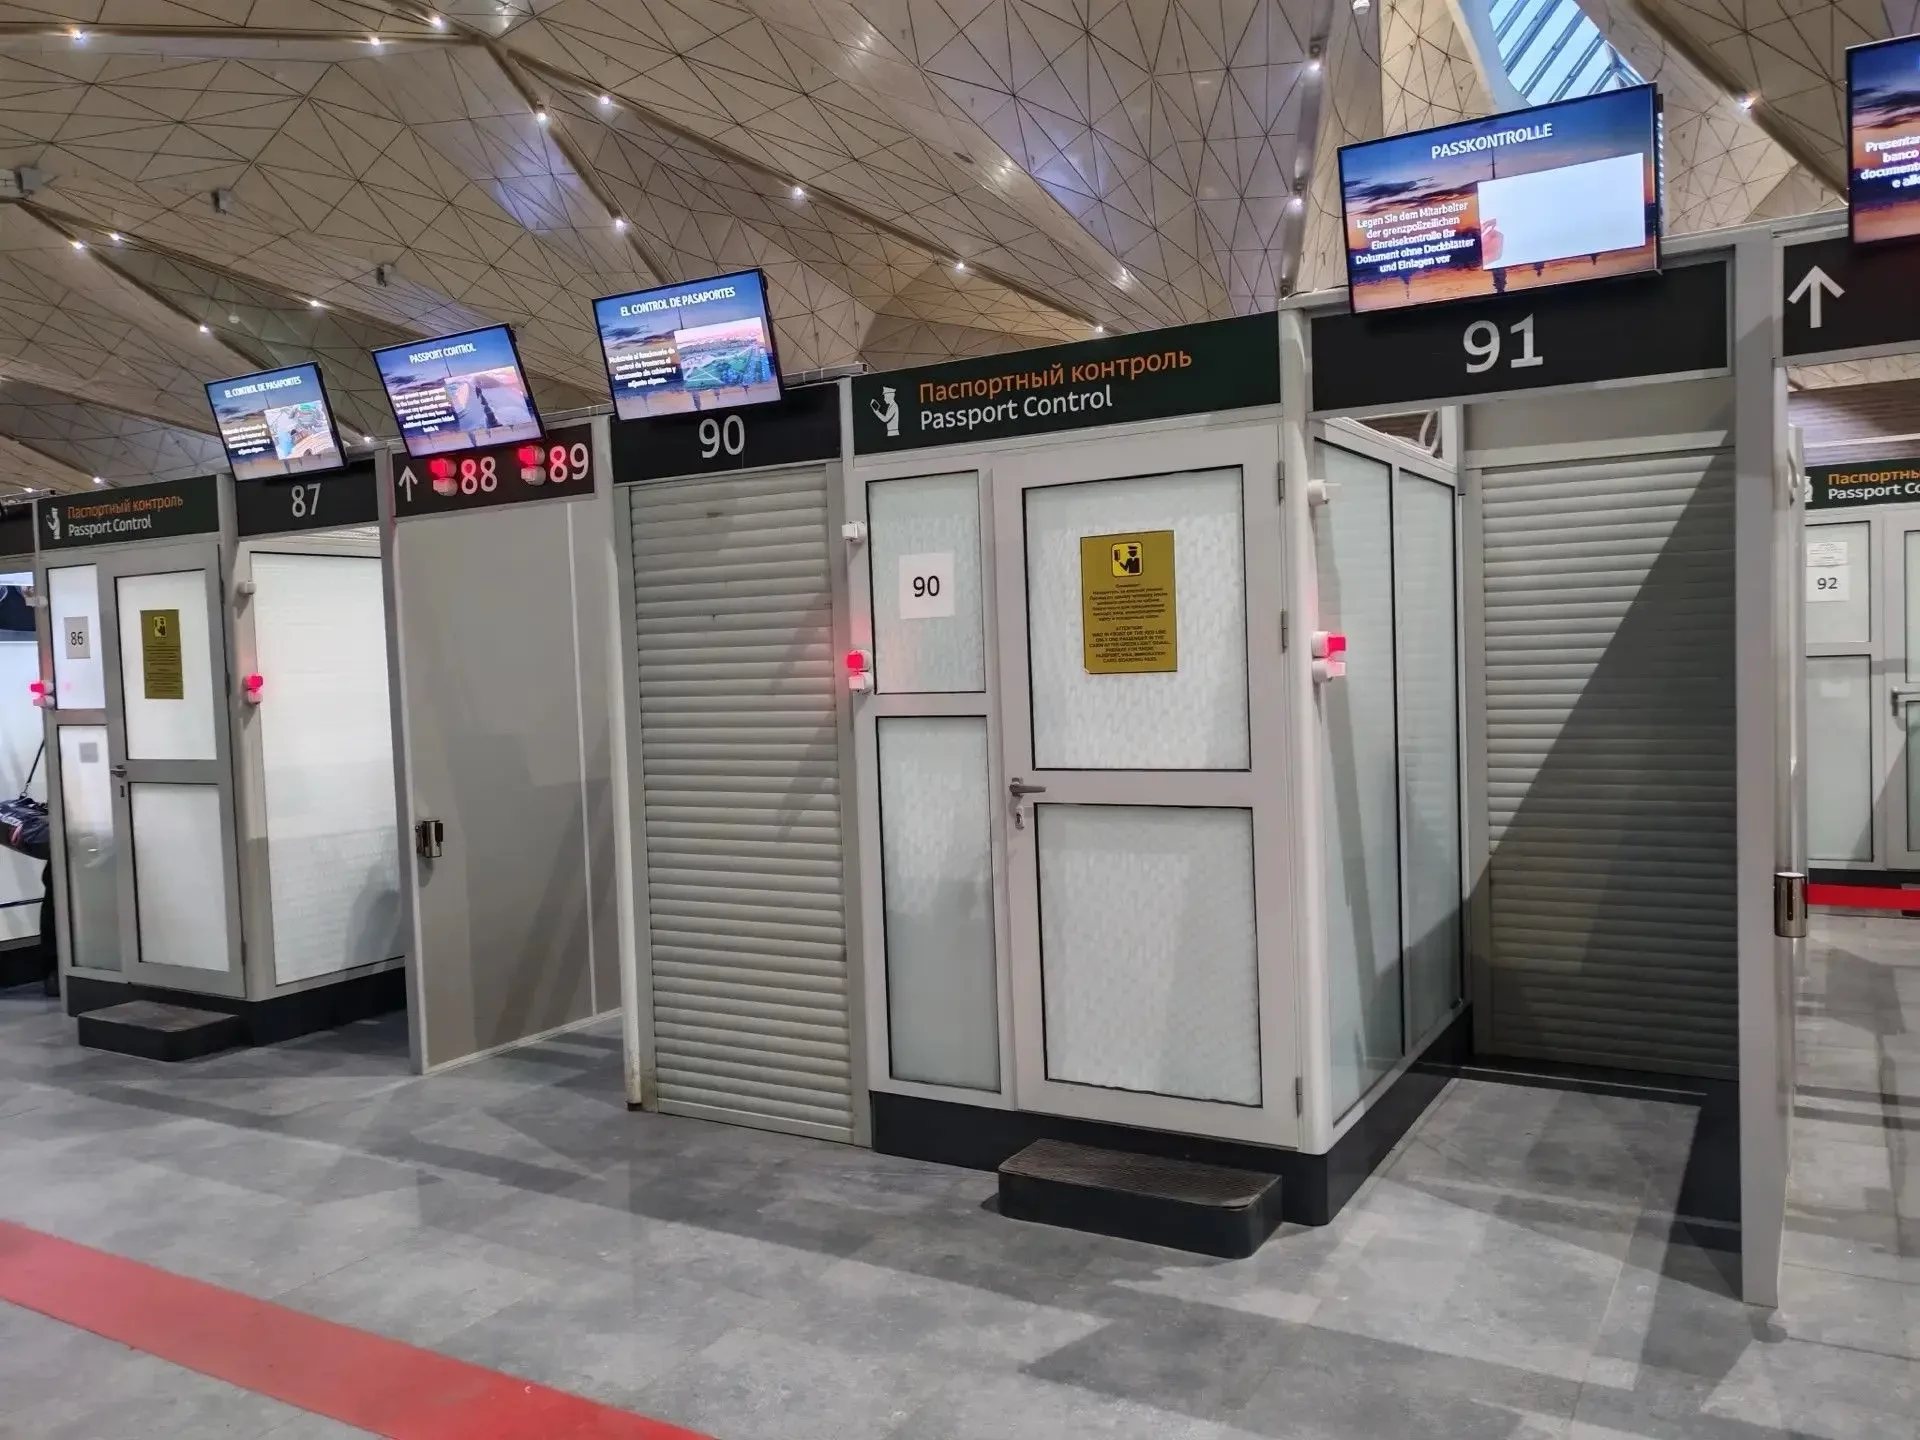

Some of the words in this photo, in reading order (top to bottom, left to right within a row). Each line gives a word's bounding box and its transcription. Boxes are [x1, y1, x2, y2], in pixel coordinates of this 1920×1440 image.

[1431, 123, 1553, 159] PASSKONTROLLE
[1883, 150, 1919, 163] banco
[1892, 180, 1901, 188] e
[1357, 217, 1383, 228] Legen
[1384, 213, 1398, 224] Sie
[1399, 210, 1418, 221] dem
[1419, 201, 1468, 218] Mitarbeiter
[1366, 228, 1381, 239] der
[1383, 216, 1460, 238] grenzpolizeilichen
[1371, 231, 1442, 250] Einreisekontrolle
[1443, 229, 1456, 238] Ihr
[1355, 251, 1400, 265] Dokument
[1401, 247, 1423, 257] ohne
[1424, 238, 1475, 254] Deckblätter
[1379, 262, 1397, 273] und
[1398, 257, 1435, 270] Einlagen
[1435, 255, 1451, 264] vor
[620, 306, 631, 317] EL
[631, 300, 669, 314] CONTROL
[670, 297, 682, 308] DE
[682, 287, 736, 305] PASAPORTES
[409, 348, 443, 364] PASSPORT
[443, 343, 477, 358] CONTROL
[1462, 313, 1544, 374] 91
[919, 363, 1064, 404] Паспортный
[1071, 349, 1193, 383] контроль
[919, 402, 1017, 431] Passport
[1023, 384, 1114, 417] Control
[699, 414, 745, 459] 90
[461, 456, 498, 495] 88
[549, 442, 589, 483] 89
[291, 482, 322, 518] 87
[1828, 484, 1902, 500] Passport
[67, 499, 131, 519] Паспортный
[132, 495, 184, 513] контроль
[68, 519, 112, 538] Passport
[112, 514, 152, 531] Control
[913, 575, 940, 598] 90
[1817, 577, 1839, 590] 92
[70, 631, 84, 646] 86
